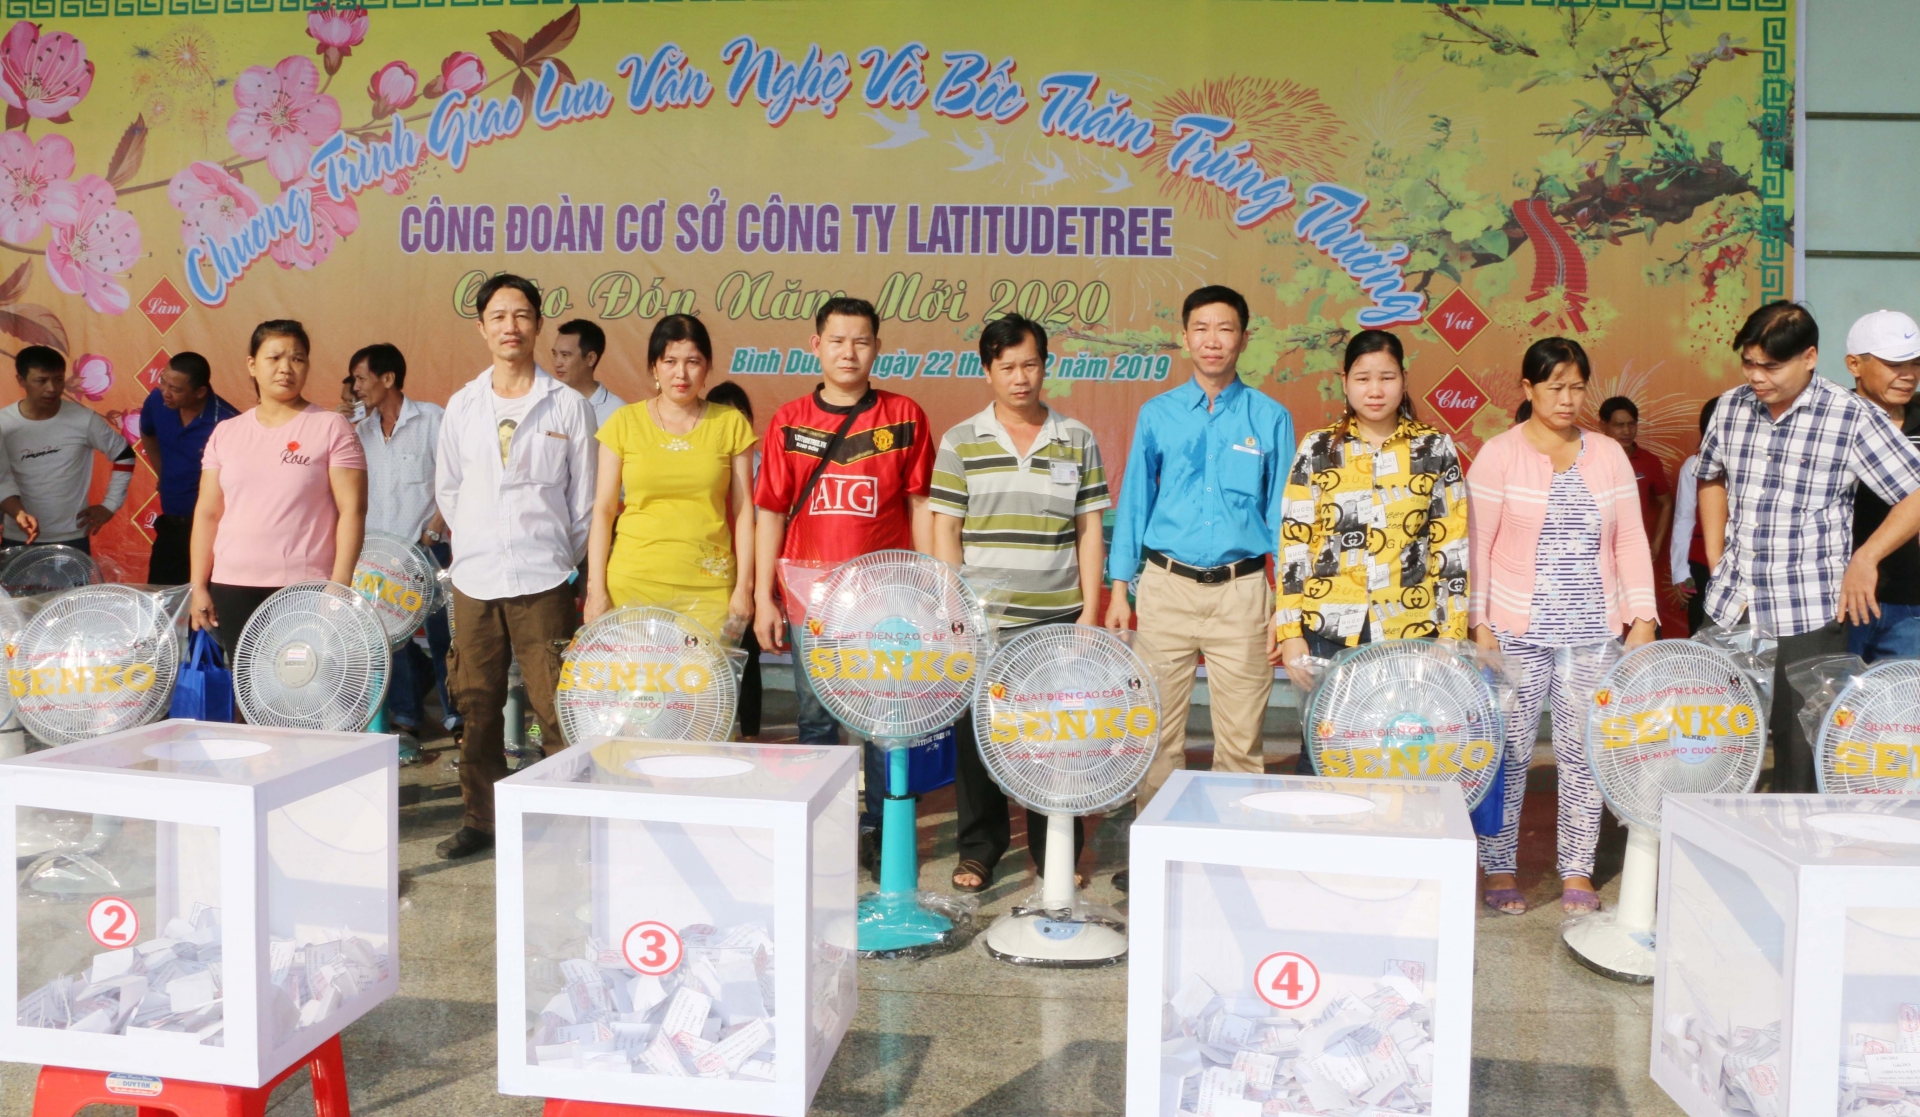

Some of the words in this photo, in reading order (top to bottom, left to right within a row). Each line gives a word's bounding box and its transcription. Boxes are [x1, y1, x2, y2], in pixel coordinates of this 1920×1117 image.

[185, 187, 315, 306] Chương
[309, 112, 418, 203] Trình
[427, 89, 524, 169] Giao
[533, 61, 613, 128] Lưu
[617, 42, 713, 114] Văn
[721, 35, 850, 125] Nghệ
[933, 50, 1026, 120] Bốc
[1038, 72, 1156, 156] Thăm
[1167, 114, 1297, 228] Trúng
[1295, 182, 1424, 328] Thưởng
[400, 194, 495, 253] CÔNG
[506, 193, 605, 252] ĐOÀN
[616, 199, 666, 254] CƠ
[676, 186, 727, 254] SỞ
[737, 192, 841, 254] CÔNG
[852, 203, 896, 255] TY
[907, 205, 1174, 258] LATITUDETREE
[146, 298, 181, 315] Làm
[588, 270, 701, 320] Đón
[874, 271, 969, 322] Mới
[982, 279, 1110, 325] 2020
[1443, 311, 1475, 331] Vui
[729, 347, 783, 375] Bình
[921, 350, 955, 377] 22
[1057, 352, 1108, 380] năm
[1112, 354, 1172, 381] 2019
[1435, 389, 1479, 409] Chơi
[280, 449, 310, 466] Rose
[813, 478, 873, 512] AIG
[895, 632, 920, 640] CAO
[9, 663, 156, 697] SENKO
[557, 661, 710, 694] SENKO
[809, 647, 976, 682] SENKO
[1076, 691, 1099, 699] CAO
[991, 706, 1157, 743] SENKO
[1601, 704, 1756, 749] SENKO
[1320, 740, 1494, 778] SENKO
[102, 904, 127, 941] 2
[638, 929, 668, 968] 3
[1271, 961, 1304, 1001] 4
